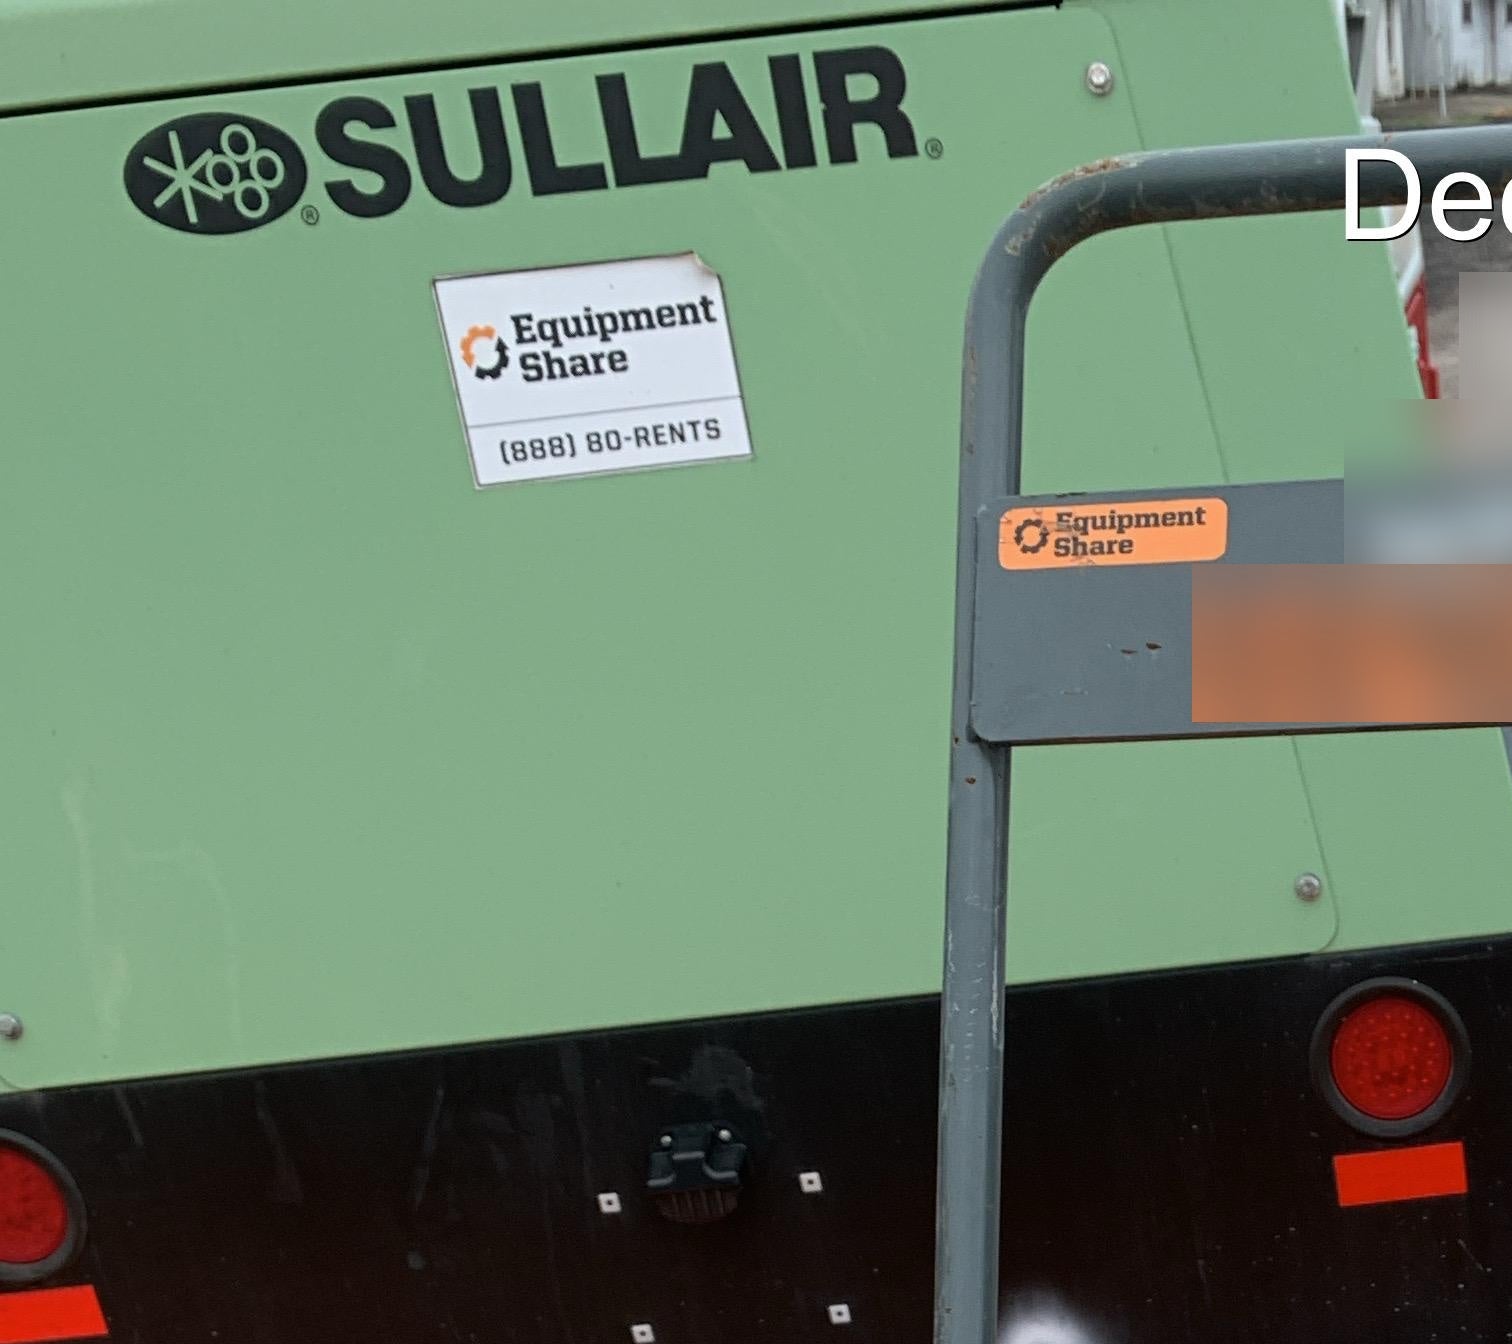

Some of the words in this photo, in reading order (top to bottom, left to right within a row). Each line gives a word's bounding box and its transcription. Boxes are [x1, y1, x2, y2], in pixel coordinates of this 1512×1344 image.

[314, 45, 919, 218] SULLAIR
[510, 295, 717, 348] Equipment
[518, 350, 629, 382] Share
[499, 432, 577, 465] (888)
[586, 418, 722, 453] 80-RENTS
[1054, 507, 1207, 536] Equipment
[1053, 537, 1134, 558] Share
